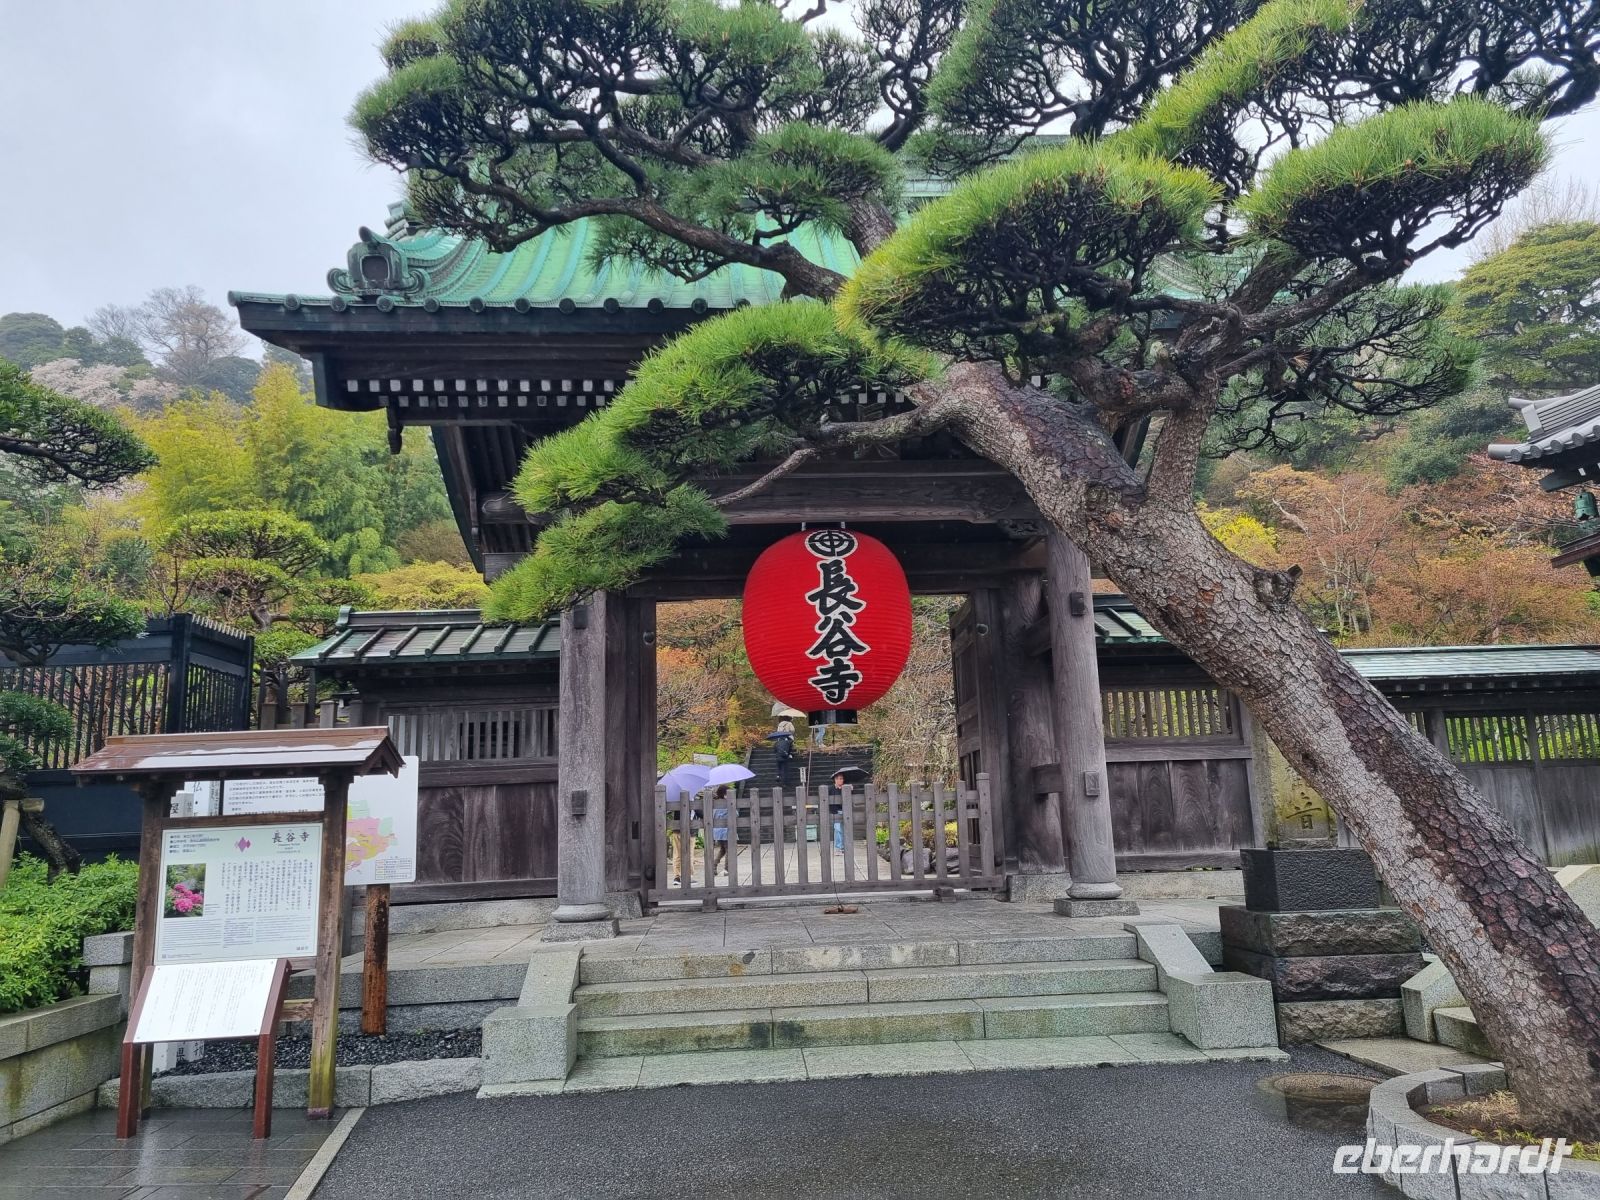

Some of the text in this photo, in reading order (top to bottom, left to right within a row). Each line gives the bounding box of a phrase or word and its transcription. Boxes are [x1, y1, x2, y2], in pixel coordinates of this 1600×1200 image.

[806, 559, 869, 704] 長谷寺
[272, 831, 310, 843] 長谷寺
